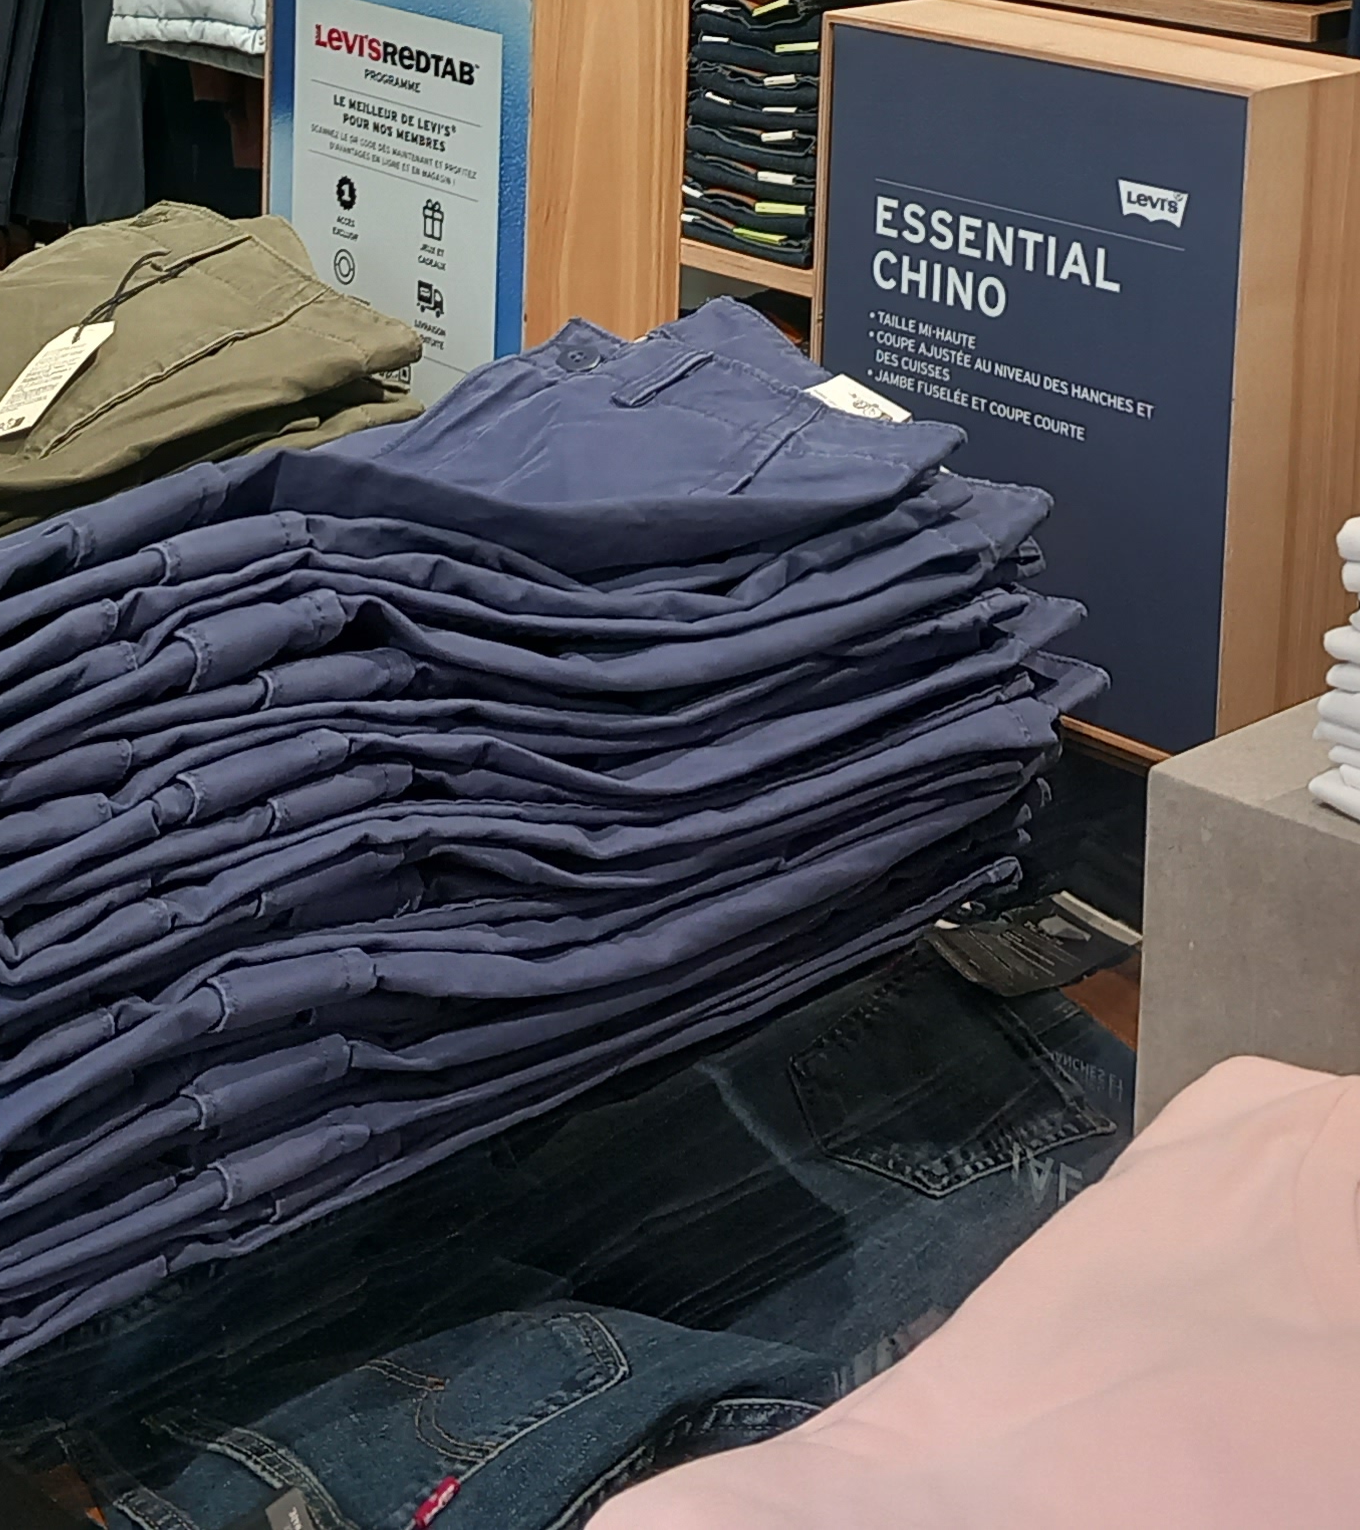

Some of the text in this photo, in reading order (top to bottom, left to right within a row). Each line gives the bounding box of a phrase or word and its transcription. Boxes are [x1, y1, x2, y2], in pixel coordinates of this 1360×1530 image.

[364, 68, 422, 94] PROGRAMME
[333, 94, 346, 108] LE
[348, 97, 398, 123] MEILLEUR
[400, 113, 415, 127] DE
[342, 113, 446, 153] POUR NOS MEMBRES
[874, 194, 1122, 294] ESSENTIAL
[872, 249, 1007, 318] CHINO
[877, 310, 977, 350] TAILLE MI-HAUTE
[875, 349, 951, 382] DES CUISSES
[876, 330, 1155, 421] COUPE AJUSTÉE AU NIVEAU DES HANCHES ET
[874, 369, 1086, 442] JAMBE FUSELÉE ET COUPE COURTE
